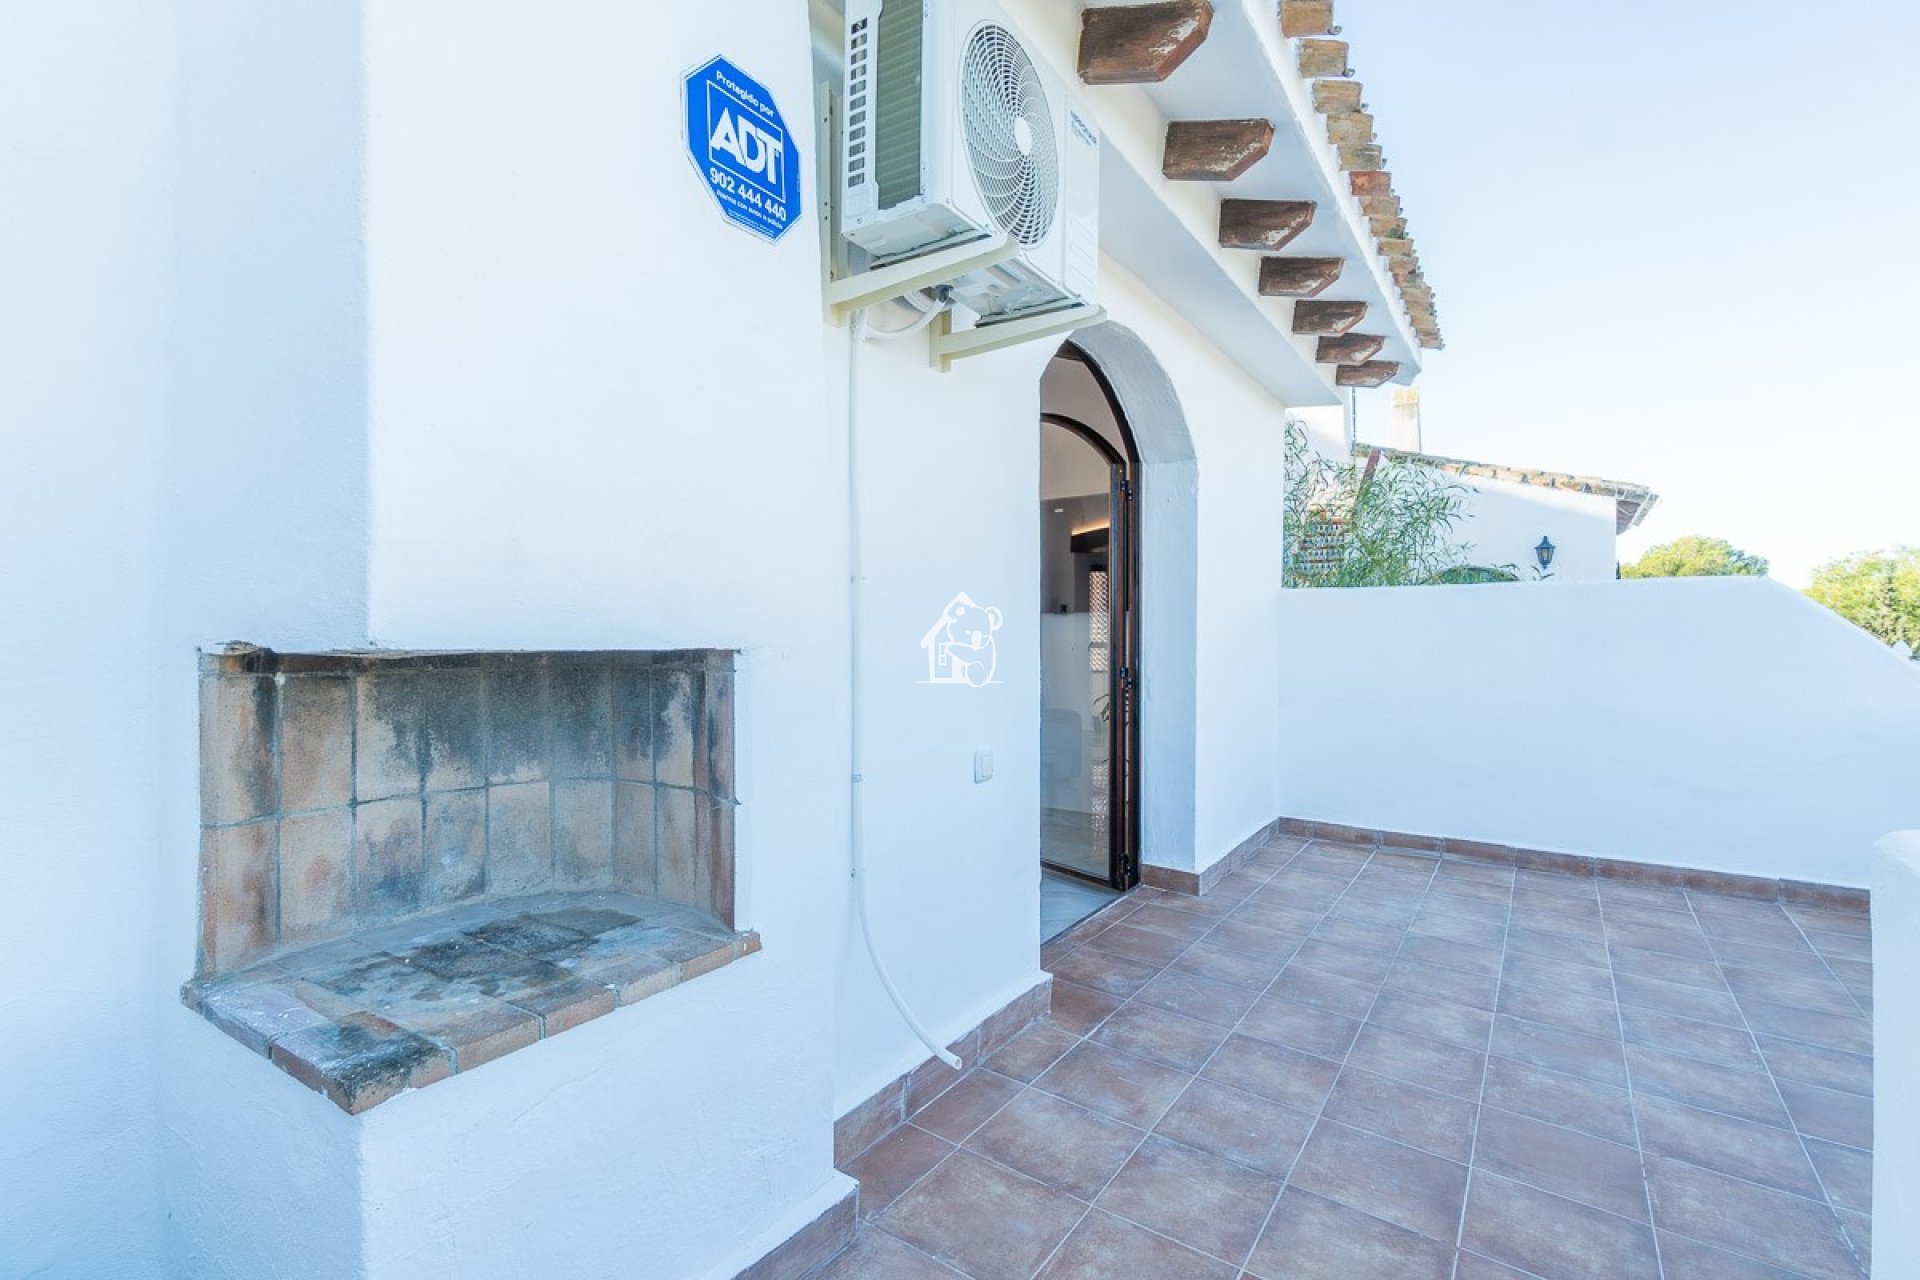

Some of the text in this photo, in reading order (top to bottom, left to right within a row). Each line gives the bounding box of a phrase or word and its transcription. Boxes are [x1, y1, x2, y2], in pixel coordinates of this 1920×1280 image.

[717, 69, 774, 118] Protegido por
[710, 107, 783, 185] ADT
[710, 167, 787, 222] 902 444 440
